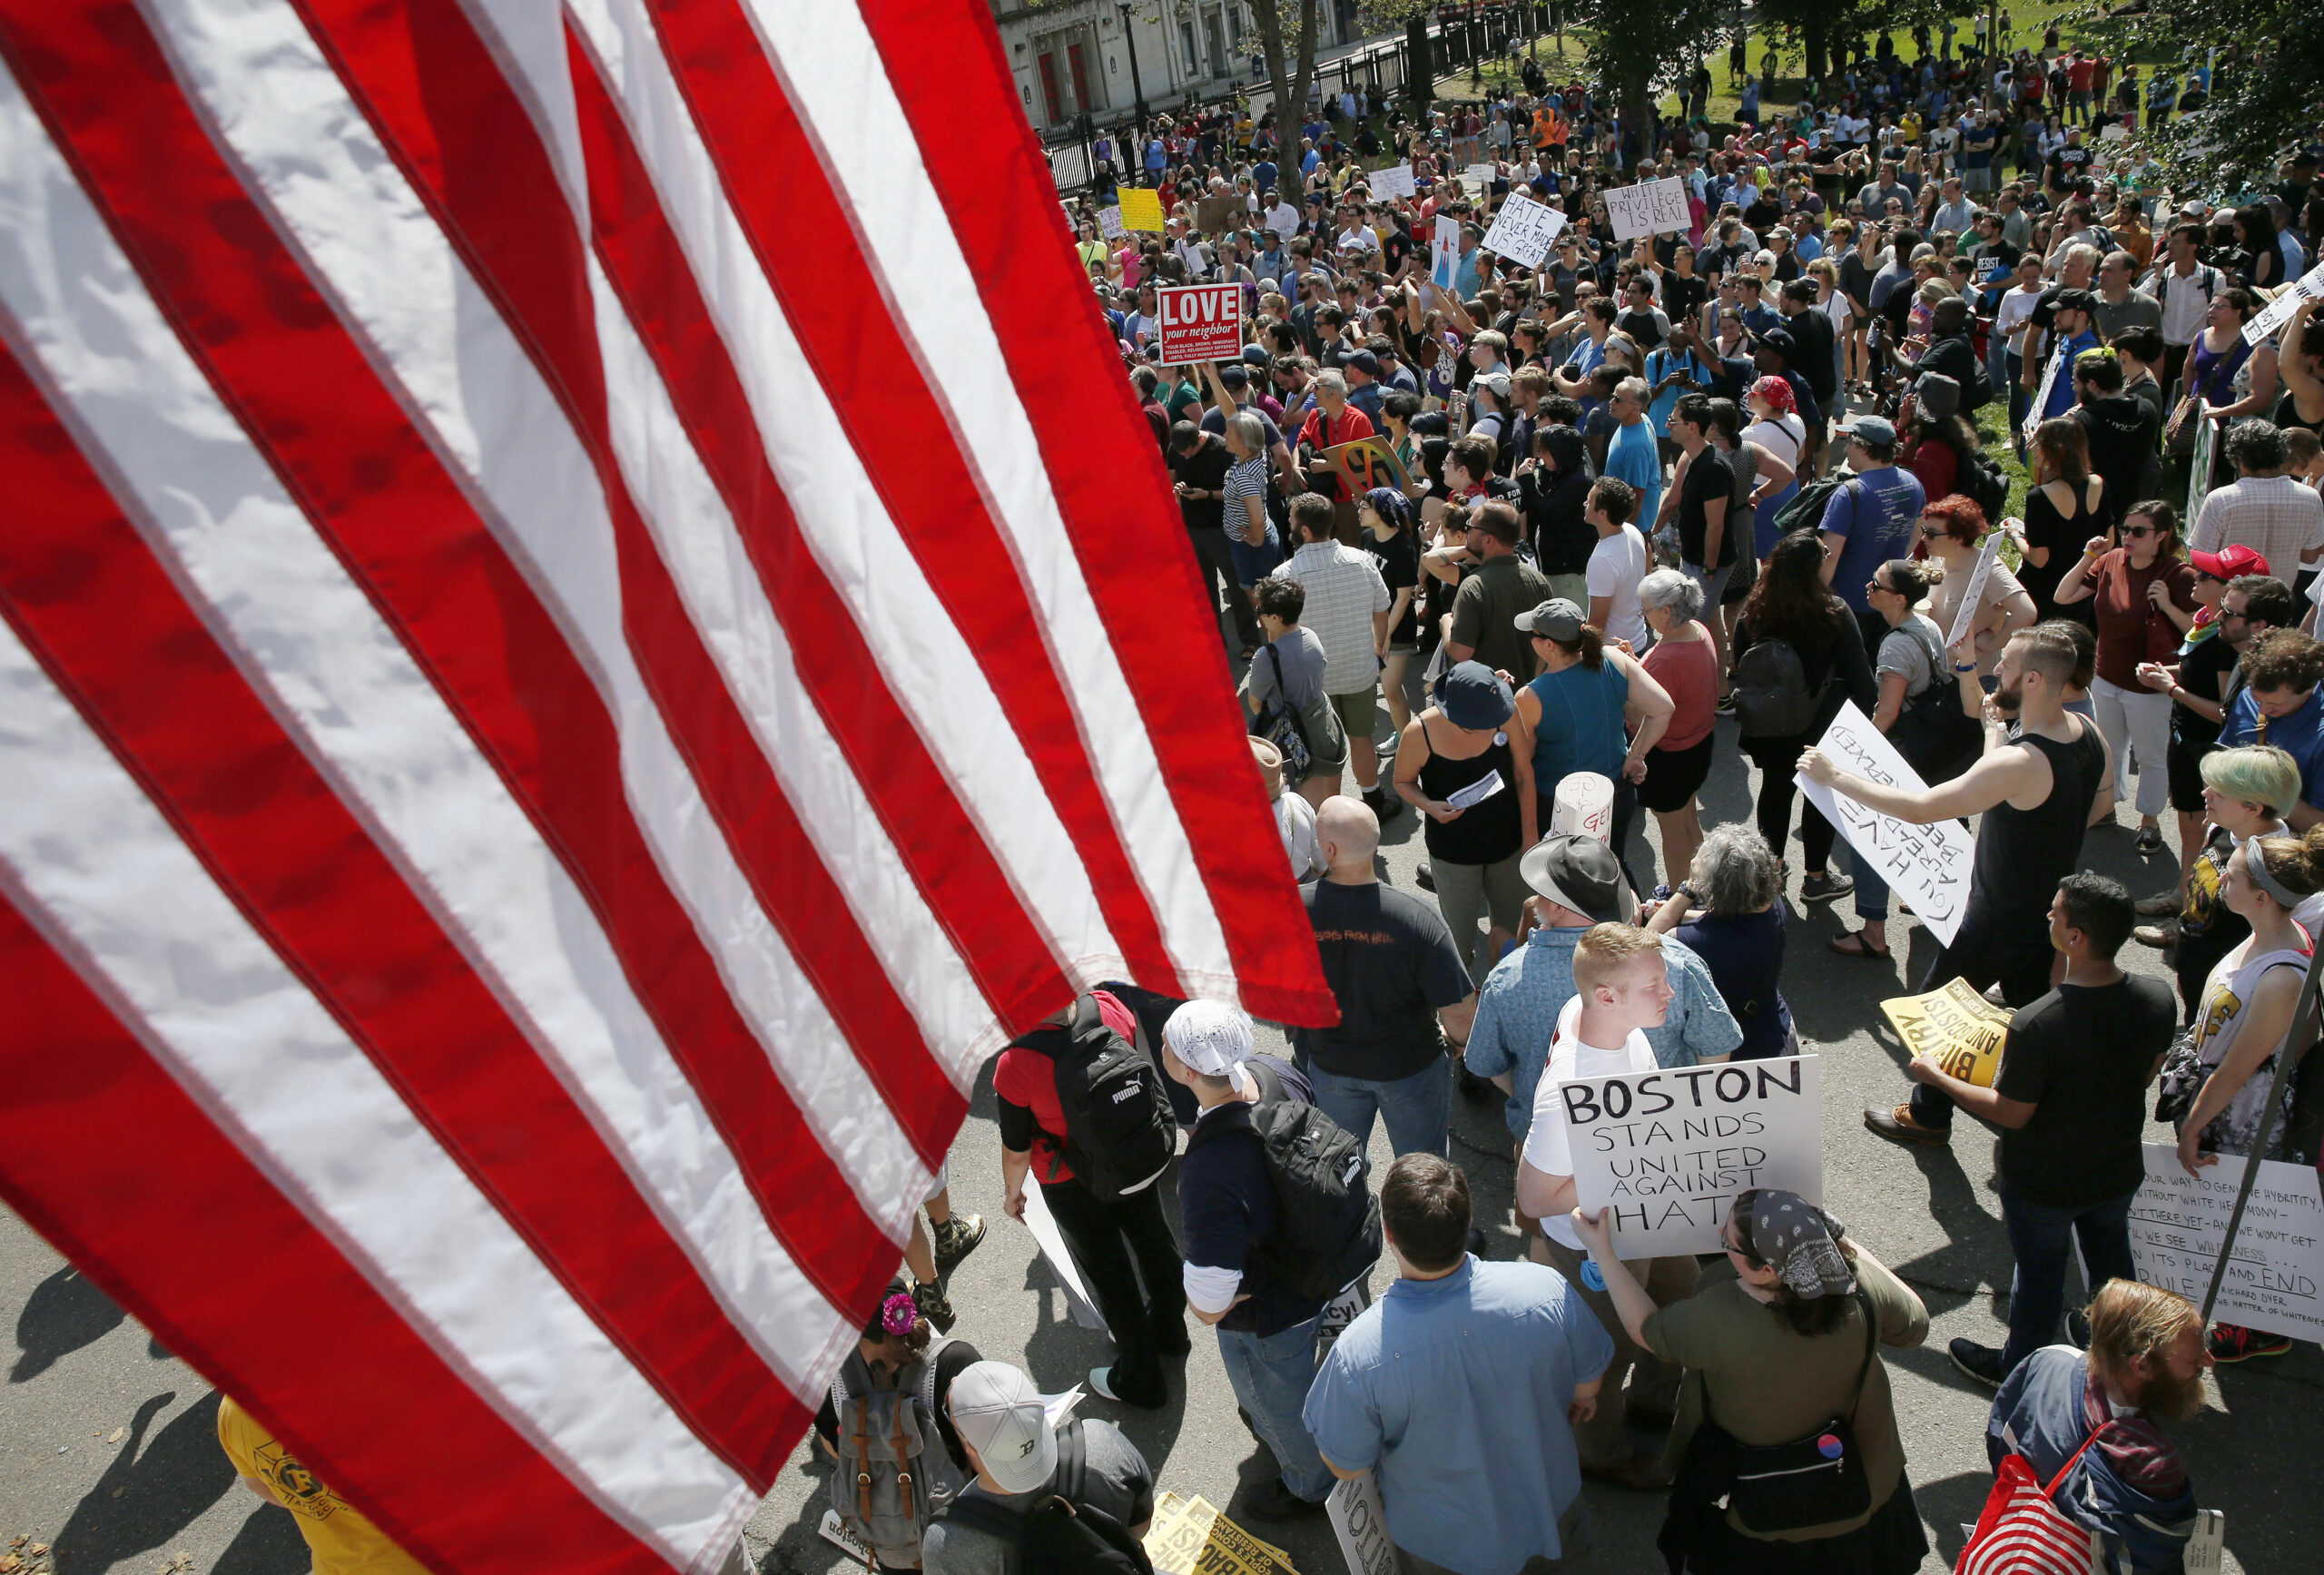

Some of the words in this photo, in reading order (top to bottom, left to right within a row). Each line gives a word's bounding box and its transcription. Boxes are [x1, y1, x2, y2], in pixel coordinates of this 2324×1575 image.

[1610, 192, 1682, 213] PRIVILEGE
[1621, 182, 1662, 199] WHITE
[1503, 193, 1552, 230] HATE
[1627, 211, 1648, 227] IS
[1653, 206, 1689, 223] REAL
[1491, 230, 1513, 249] US
[1512, 240, 1543, 263] GREAT
[1494, 213, 1530, 238] NEVER
[1531, 231, 1554, 251] MADE
[1977, 258, 2000, 271] RESIST
[1163, 290, 1236, 325] LOVE
[1165, 329, 1187, 343] your
[1507, 488, 1521, 499] FOR
[1583, 804, 1610, 832] GET
[1839, 800, 1912, 878] HAVE
[1916, 822, 1964, 866] BEE
[1919, 878, 1955, 937] YOU
[1344, 930, 1369, 943] FROM
[1372, 931, 1396, 944] HELL
[1896, 1015, 1977, 1083] BITRY
[1966, 1026, 2001, 1056] AND
[1112, 1085, 1140, 1104] PUMA
[1561, 1060, 1800, 1125] BOSTON
[1592, 1112, 1765, 1151] STANDS
[1343, 1160, 1361, 1187] PUMA
[1610, 1147, 1766, 1177] UNITED
[1611, 1167, 1763, 1196] AGAINST
[2169, 1176, 2191, 1189] WAY
[2194, 1178, 2211, 1191] TO
[2214, 1183, 2260, 1199] GENNE
[1614, 1195, 1731, 1232] HAT
[2134, 1189, 2177, 1202] WITHOUT
[2181, 1195, 2215, 1208] WHITE
[2220, 1200, 2278, 1220] HEGMONY
[2148, 1209, 2180, 1222] THERE
[2184, 1216, 2203, 1227] YET
[2213, 1220, 2230, 1231] AN
[2238, 1226, 2253, 1236] WE
[2256, 1228, 2289, 1243] WON'T
[2291, 1236, 2317, 1248] GET
[2146, 1232, 2162, 1243] WE
[2166, 1235, 2187, 1248] SEE
[2196, 1240, 2267, 1262] WHITNESS
[2152, 1253, 2176, 1267] ITS
[2185, 1258, 2216, 1274] PLAC
[2230, 1267, 2255, 1281] AND
[2261, 1268, 2316, 1295] END
[2214, 1297, 2230, 1306] THE
[2232, 1301, 2265, 1313] MATTER
[2269, 1308, 2280, 1316] OF
[2221, 1286, 2257, 1301] RICHARD
[2261, 1293, 2288, 1306] DYER
[1193, 1513, 1236, 1548] CONGRESS
[1211, 1513, 1259, 1556] RESISTANCE
[1257, 1555, 1273, 1566] OF
